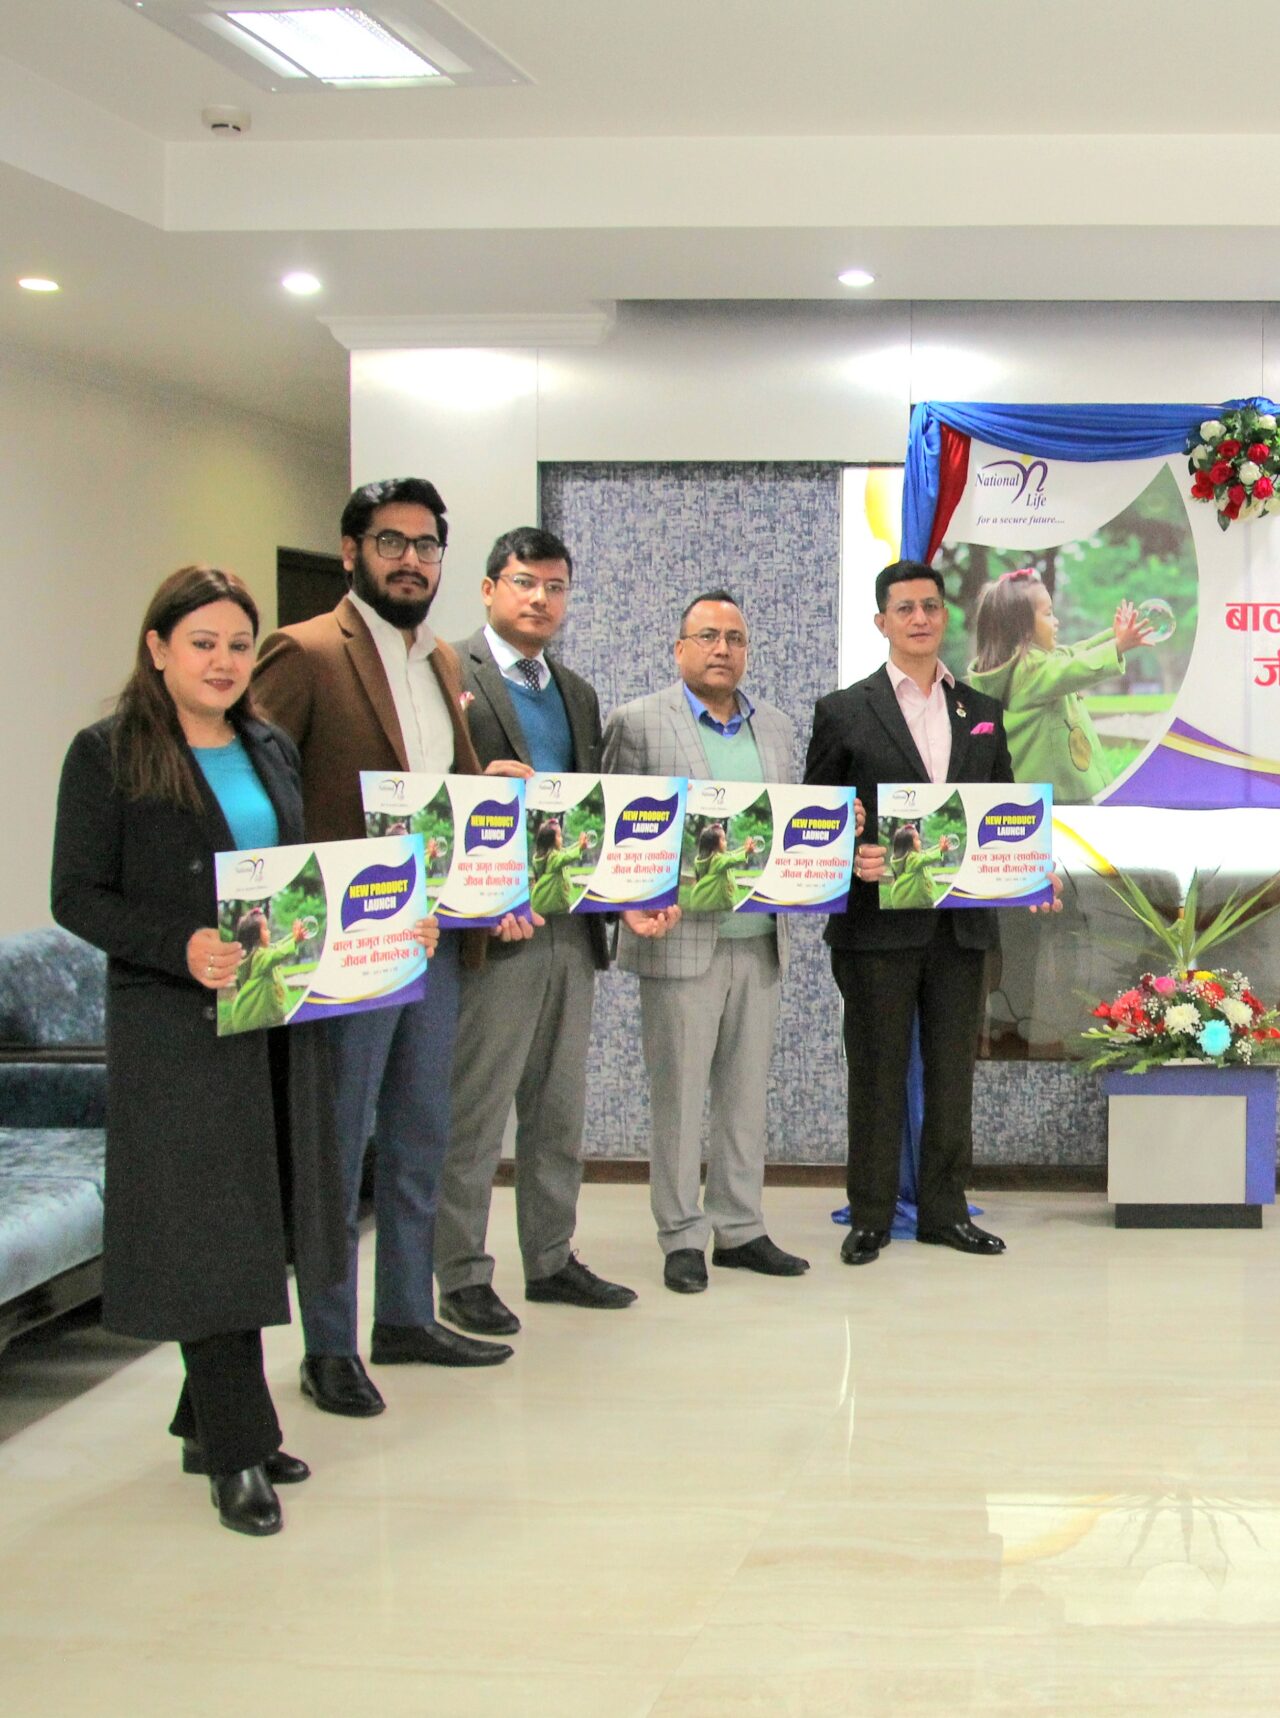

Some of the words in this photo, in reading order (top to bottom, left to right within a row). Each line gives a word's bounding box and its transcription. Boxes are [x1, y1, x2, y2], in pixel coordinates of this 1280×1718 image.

[975, 473, 1020, 487] National
[1026, 493, 1046, 510] Life
[976, 515, 990, 526] for
[622, 811, 638, 821] NEW
[638, 811, 670, 822] PRODUCT
[985, 815, 1002, 825] NEW
[1002, 815, 1036, 826] PRODUCT
[632, 822, 659, 833] LAUNCH
[791, 818, 808, 829] NEW
[808, 818, 840, 830] PRODUCT
[802, 830, 829, 841] LAUNCH
[997, 826, 1025, 836] LAUNCH
[349, 883, 368, 898] NEW
[369, 879, 408, 896] PRODUCT
[363, 896, 396, 912] LAUNCH
